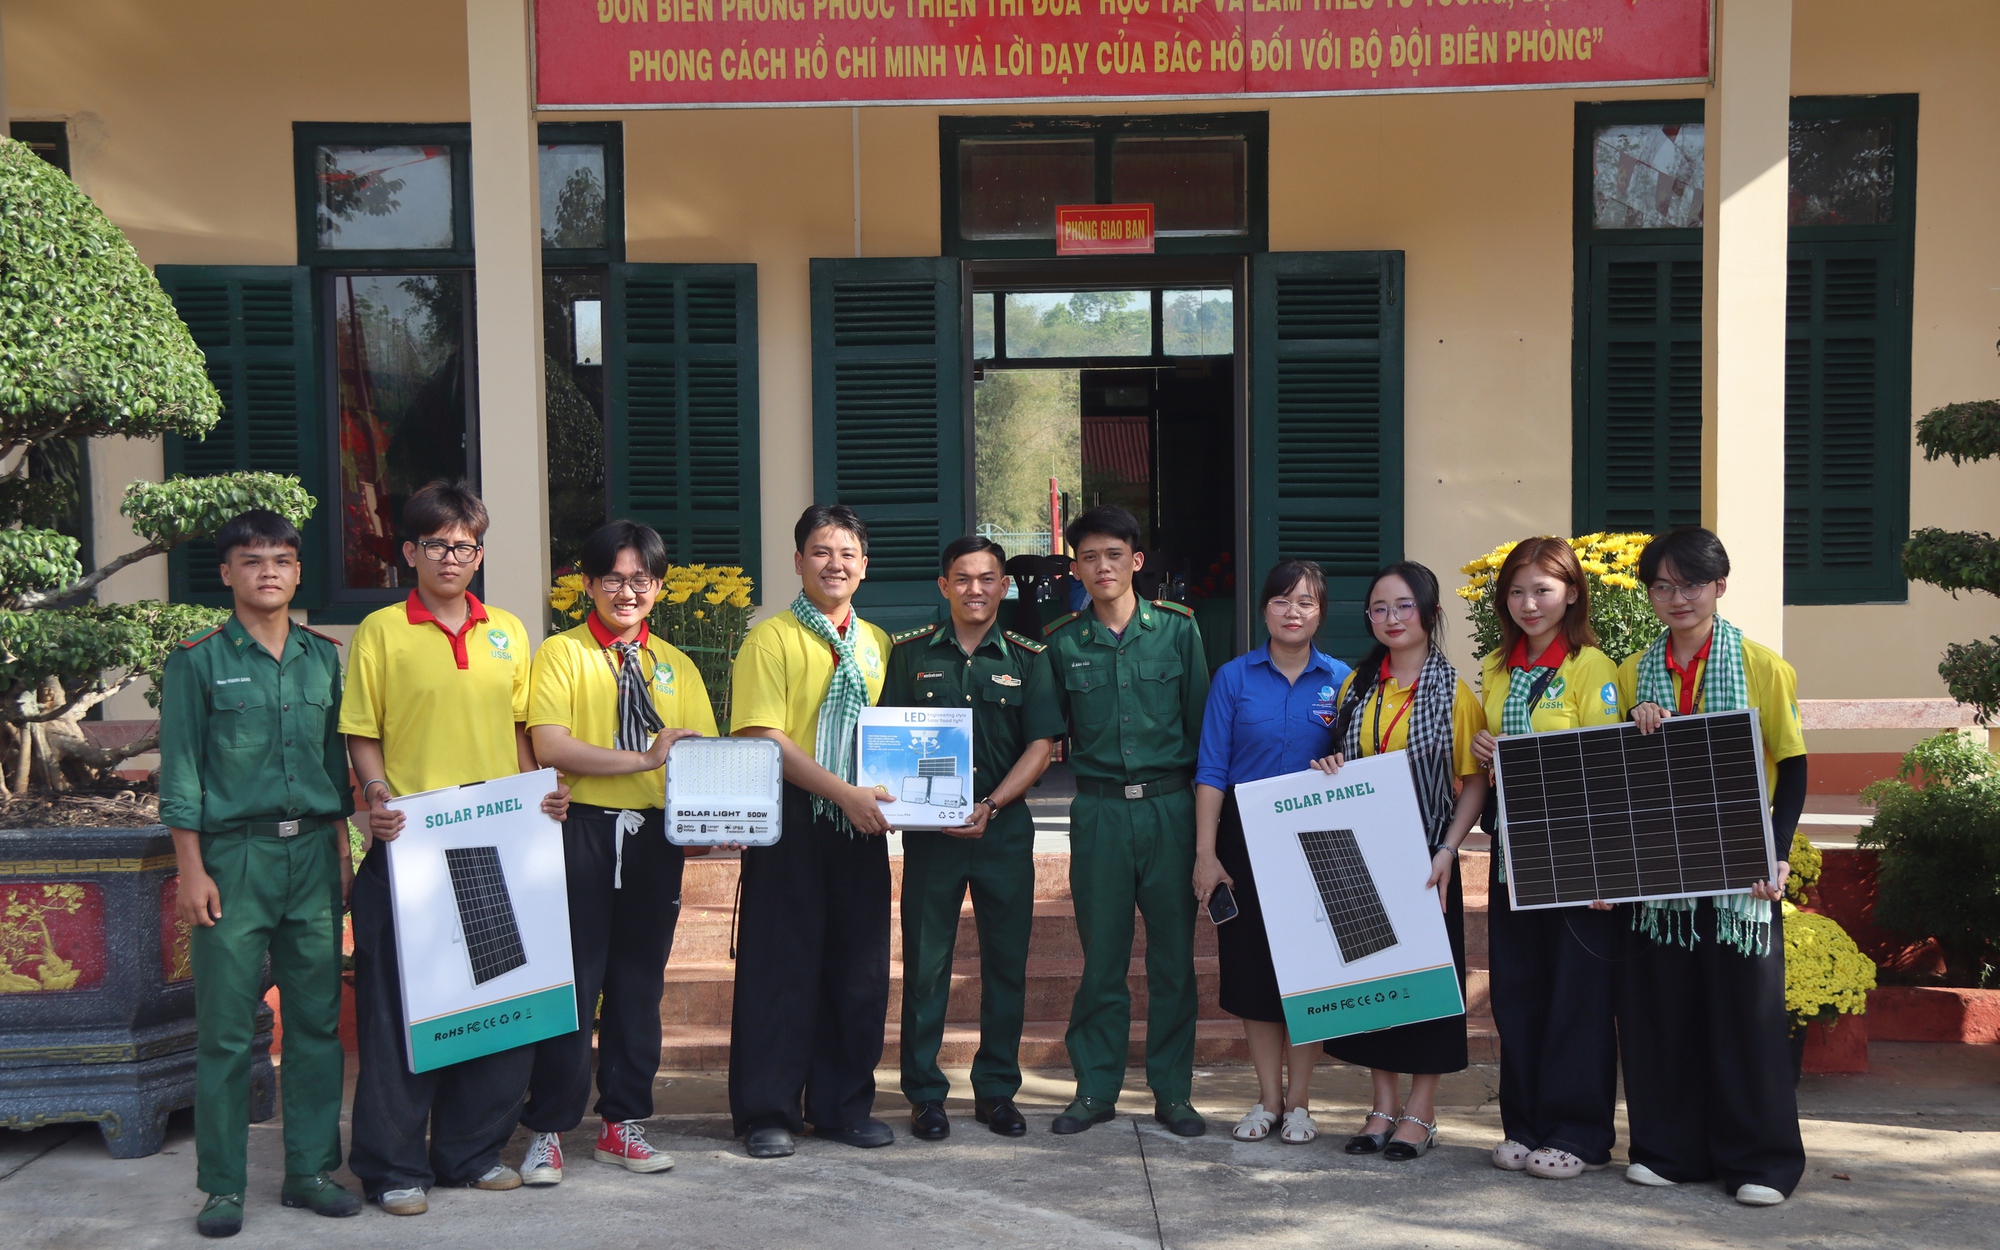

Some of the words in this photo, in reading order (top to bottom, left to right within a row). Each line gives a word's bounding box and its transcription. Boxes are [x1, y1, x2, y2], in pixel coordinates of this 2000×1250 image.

[629, 48, 713, 82] PHONG
[720, 39, 787, 81] CÁCH
[794, 33, 829, 79] HỒ
[835, 37, 877, 79] CHÍ
[885, 45, 947, 77] MINH
[954, 35, 988, 77] VÀ
[994, 34, 1033, 76] LỜI
[1040, 42, 1090, 85] DẠY
[1096, 29, 1147, 75] CỦA
[1153, 31, 1203, 73] BÁC
[1210, 25, 1245, 72] HỒ
[1250, 25, 1292, 72] ĐỐI
[1300, 28, 1342, 71] VỚI
[1349, 28, 1383, 78] BỘ
[1389, 27, 1432, 77] ĐỘI
[1440, 24, 1499, 66] BIÊN
[1065, 215, 1098, 241] PHÒNG
[1100, 219, 1123, 240] GIAO
[1125, 219, 1145, 240] BAN
[490, 650, 512, 661] USSH
[1540, 701, 1563, 709] USSH
[904, 712, 926, 722] LED
[1273, 792, 1323, 814] SOLAR
[1325, 781, 1376, 803] PANEL
[425, 808, 473, 829] SOLAR
[476, 797, 523, 818] PANEL
[1307, 1002, 1338, 1016] RoHS
[434, 1026, 464, 1041] RoHS
